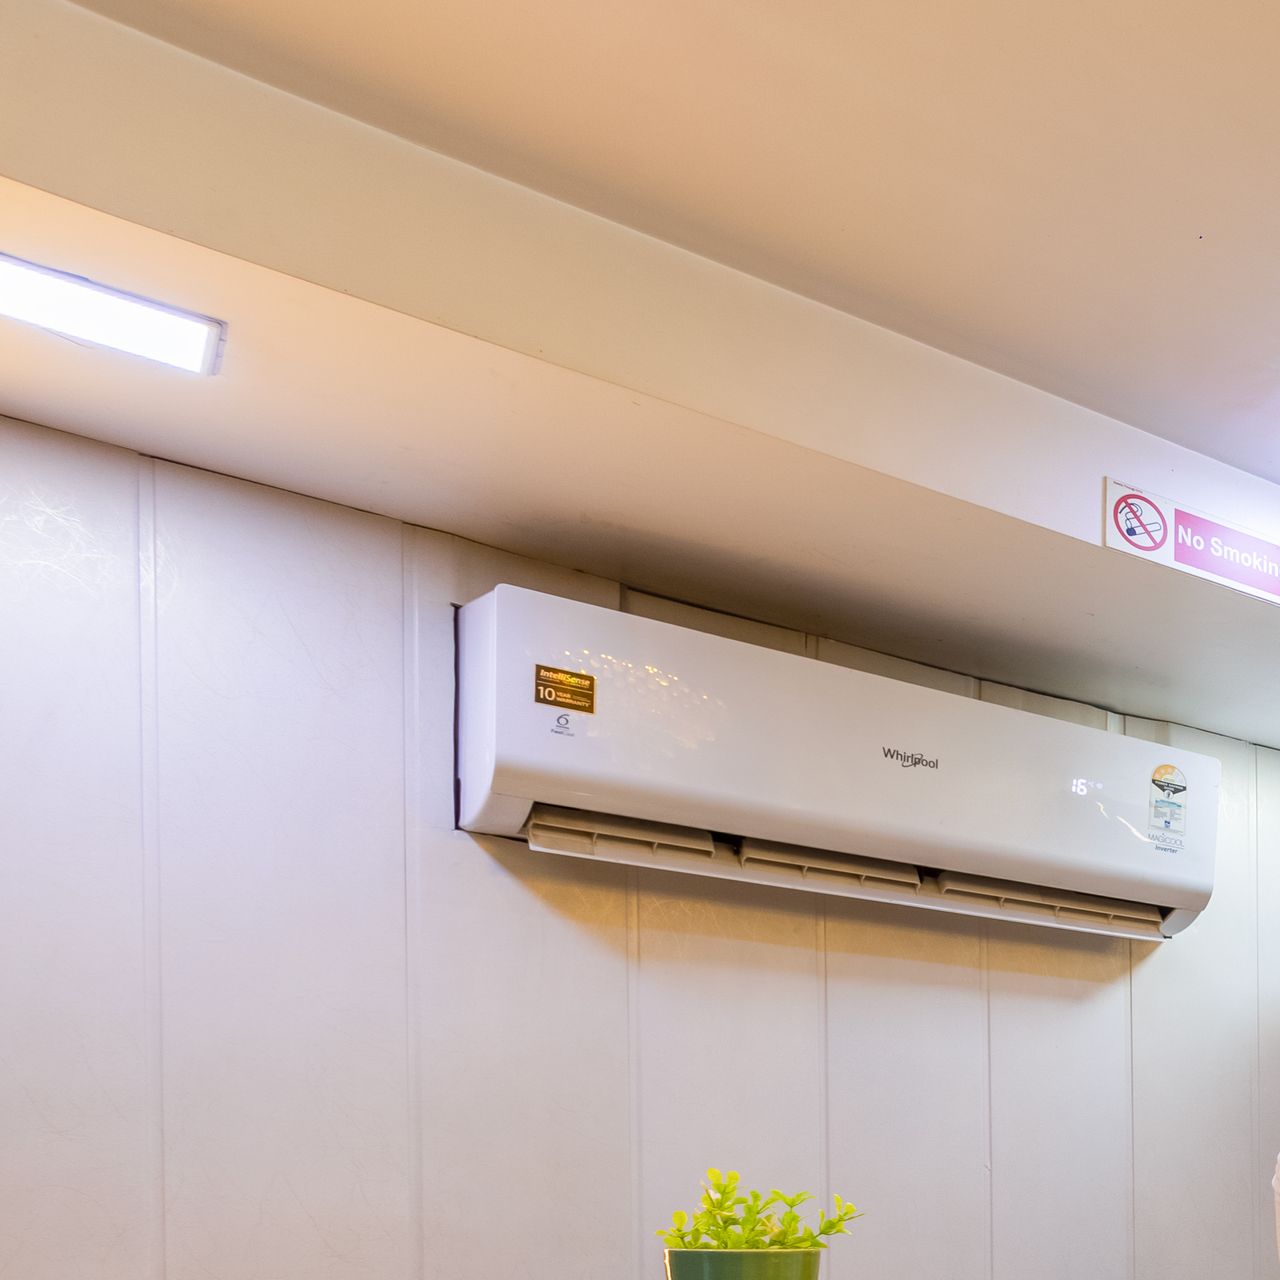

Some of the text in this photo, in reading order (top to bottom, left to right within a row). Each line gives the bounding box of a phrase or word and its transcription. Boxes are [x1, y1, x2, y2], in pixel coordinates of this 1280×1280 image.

[1178, 525, 1205, 550] No
[537, 686, 556, 700] 10
[882, 747, 939, 769] Whirlpool
